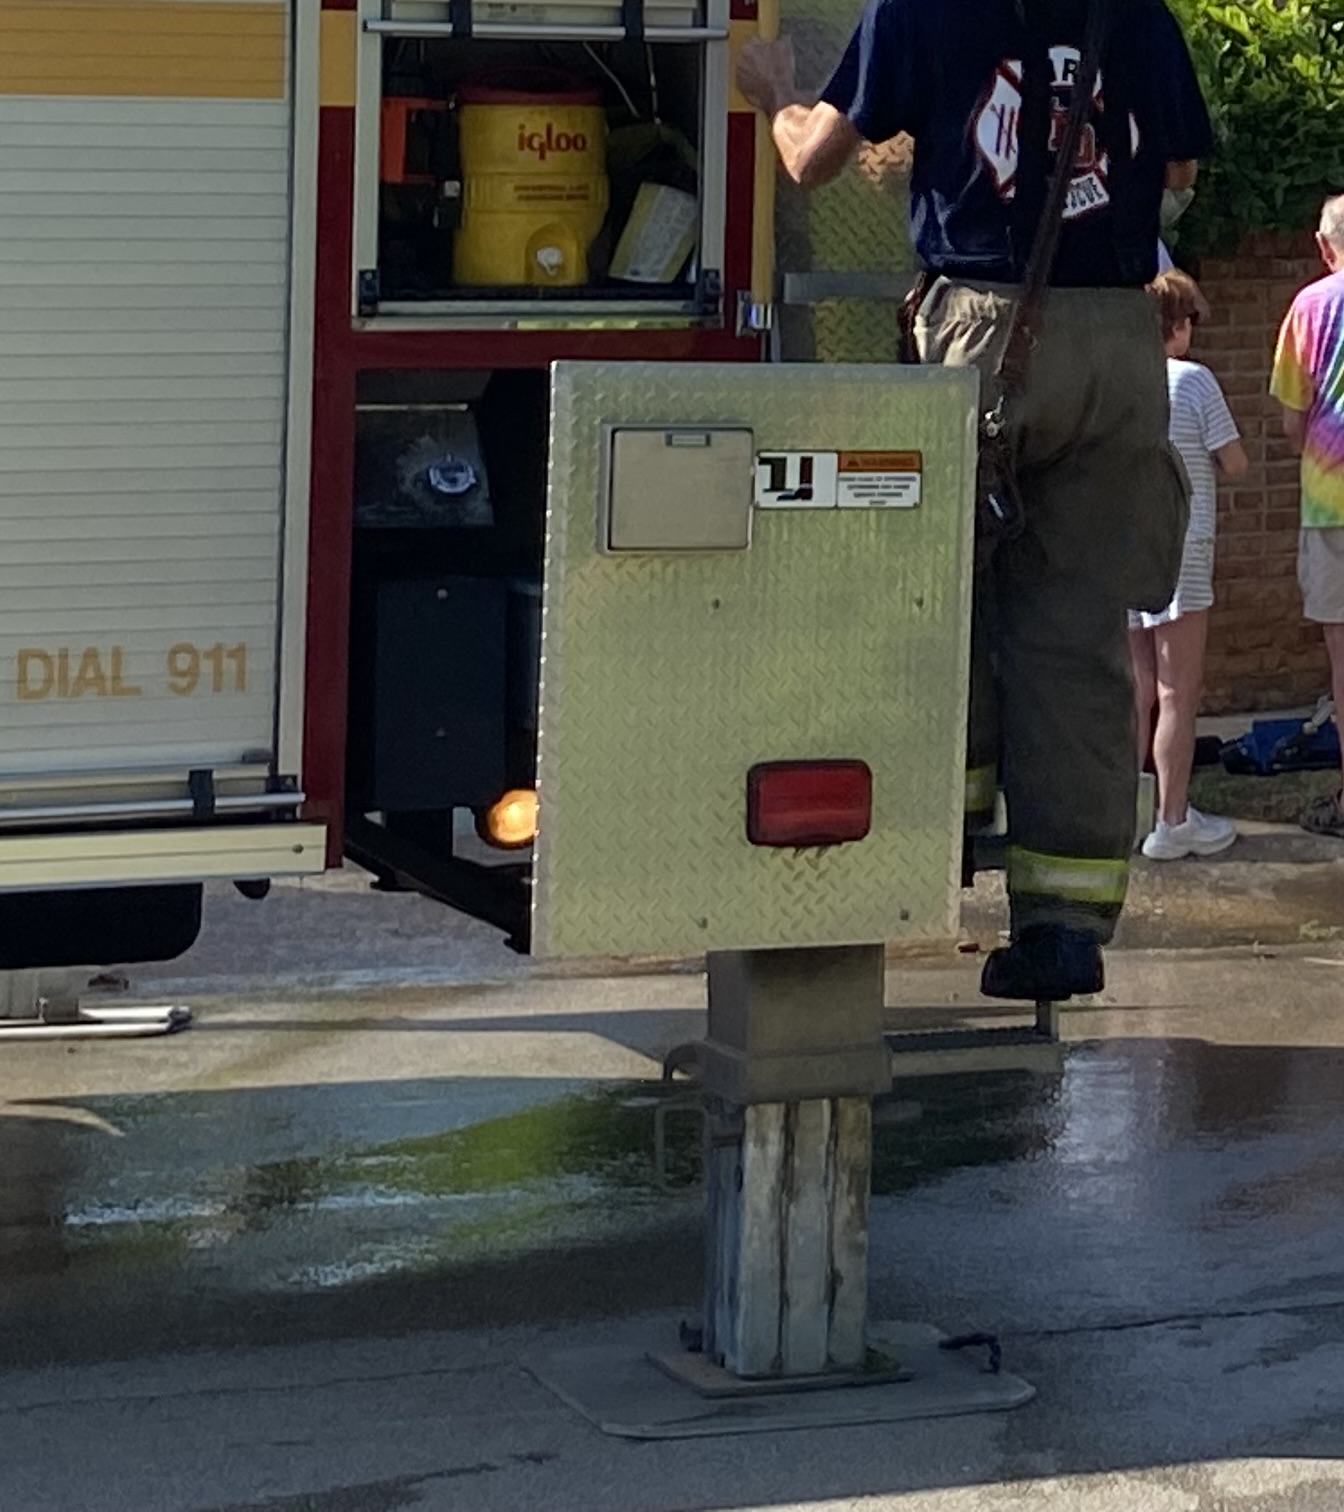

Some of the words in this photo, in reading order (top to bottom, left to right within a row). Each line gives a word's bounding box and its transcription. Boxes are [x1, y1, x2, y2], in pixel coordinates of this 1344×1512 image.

[518, 123, 587, 160] igloo
[16, 646, 142, 700] DIAL
[166, 642, 247, 697] 911
